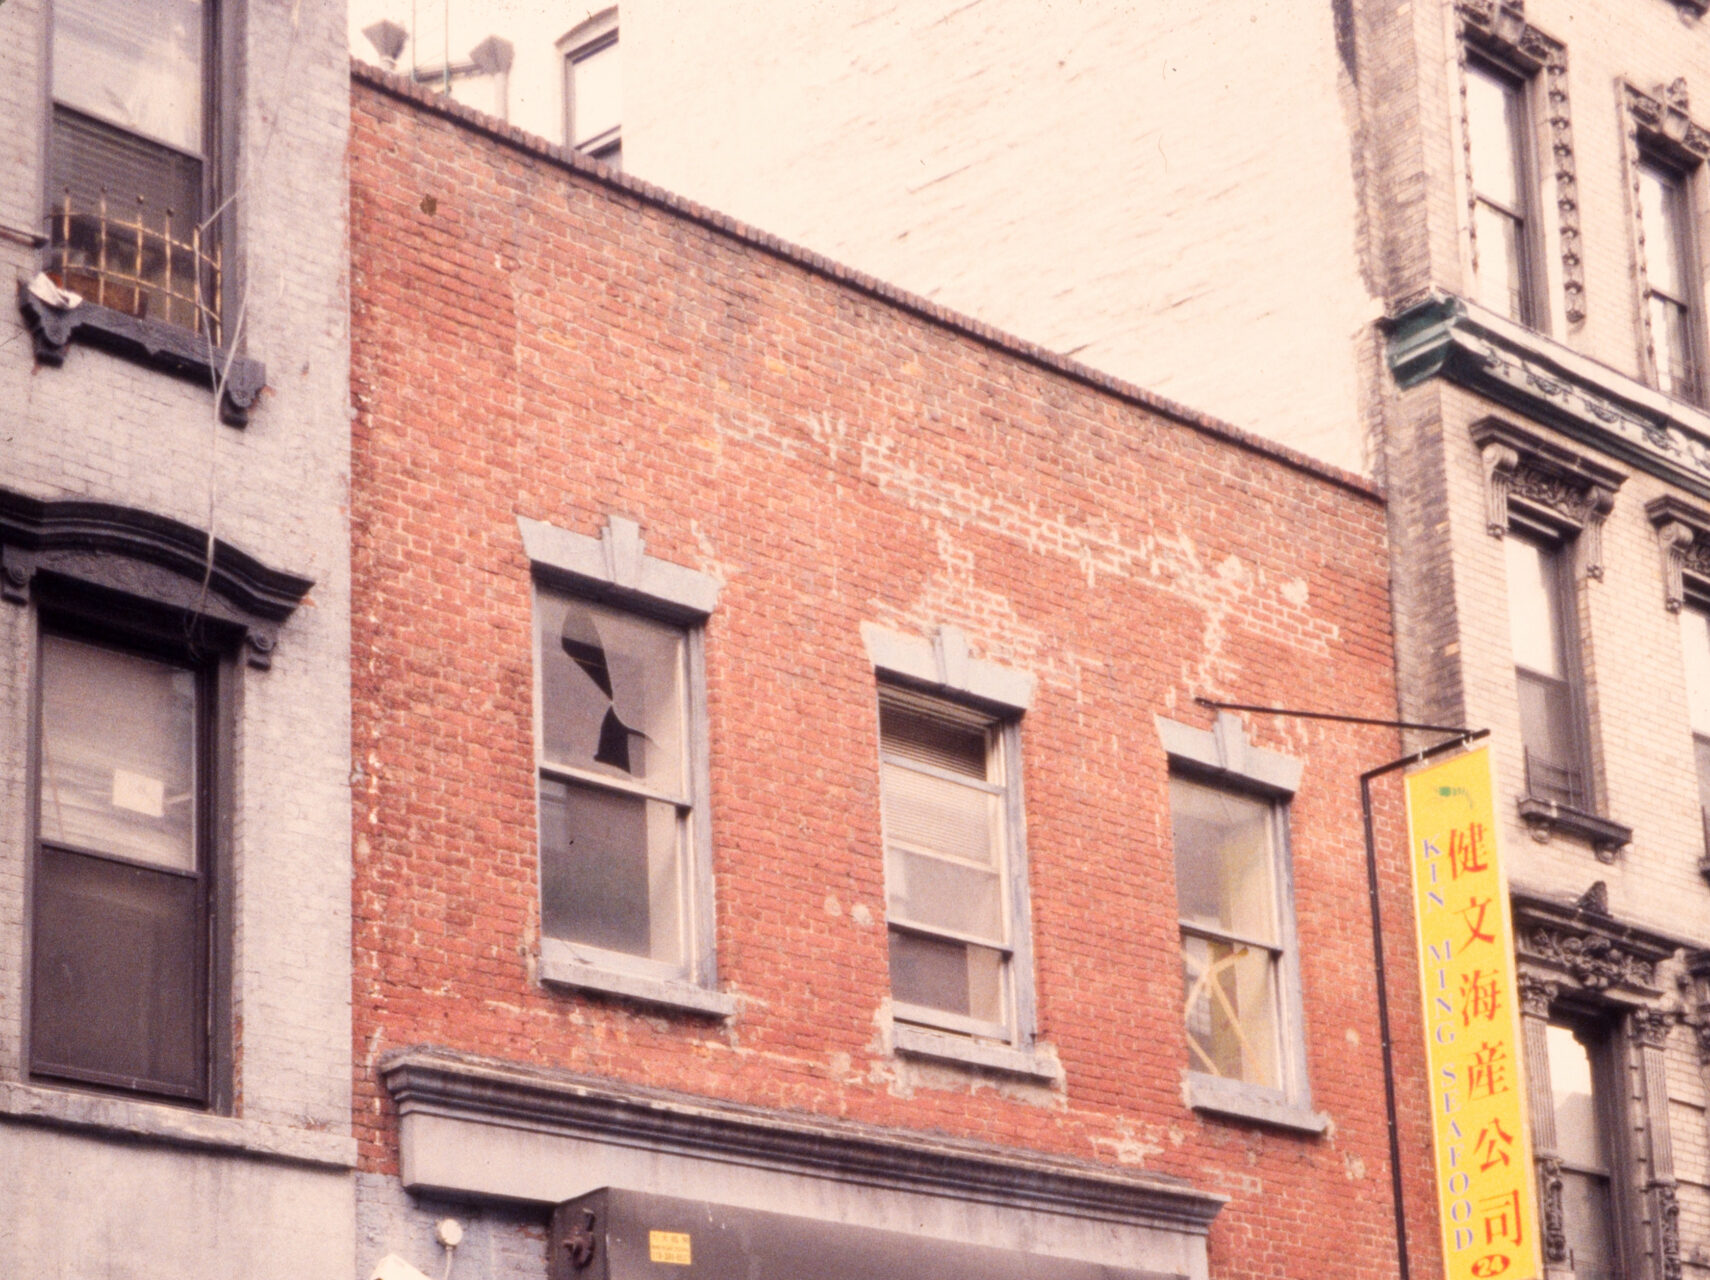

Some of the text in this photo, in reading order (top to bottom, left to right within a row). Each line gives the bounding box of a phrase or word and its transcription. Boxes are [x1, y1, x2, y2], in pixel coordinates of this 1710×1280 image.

[1421, 833, 1474, 1252] KIN MING SEAFOOD
